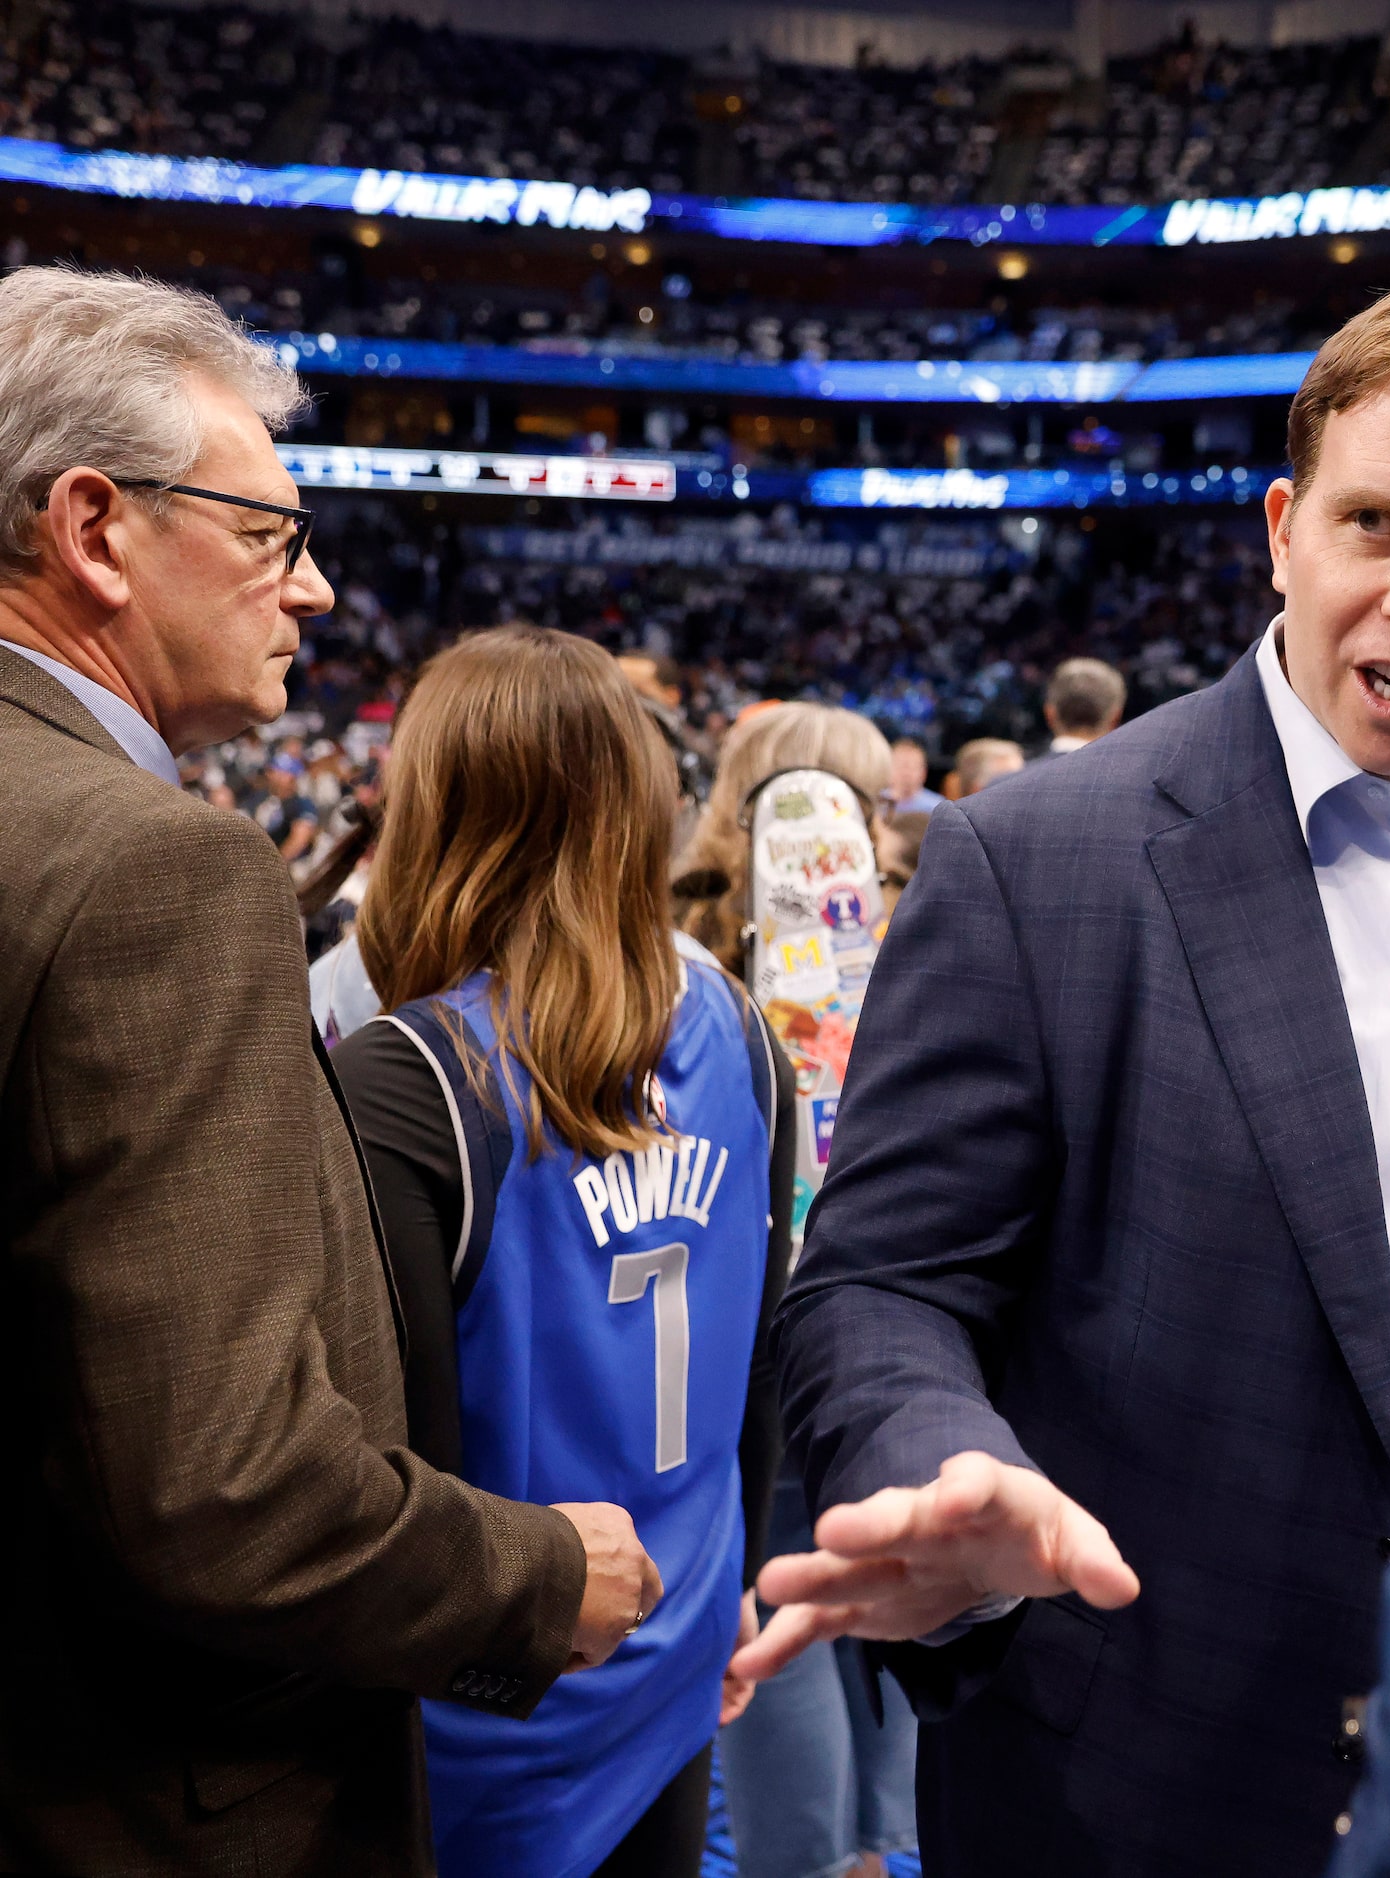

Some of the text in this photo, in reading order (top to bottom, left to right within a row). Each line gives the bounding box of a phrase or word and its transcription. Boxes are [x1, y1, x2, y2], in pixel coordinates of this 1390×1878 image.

[780, 936, 824, 974] M
[573, 1134, 729, 1249] POWELL
[608, 1241, 690, 1475] 7
